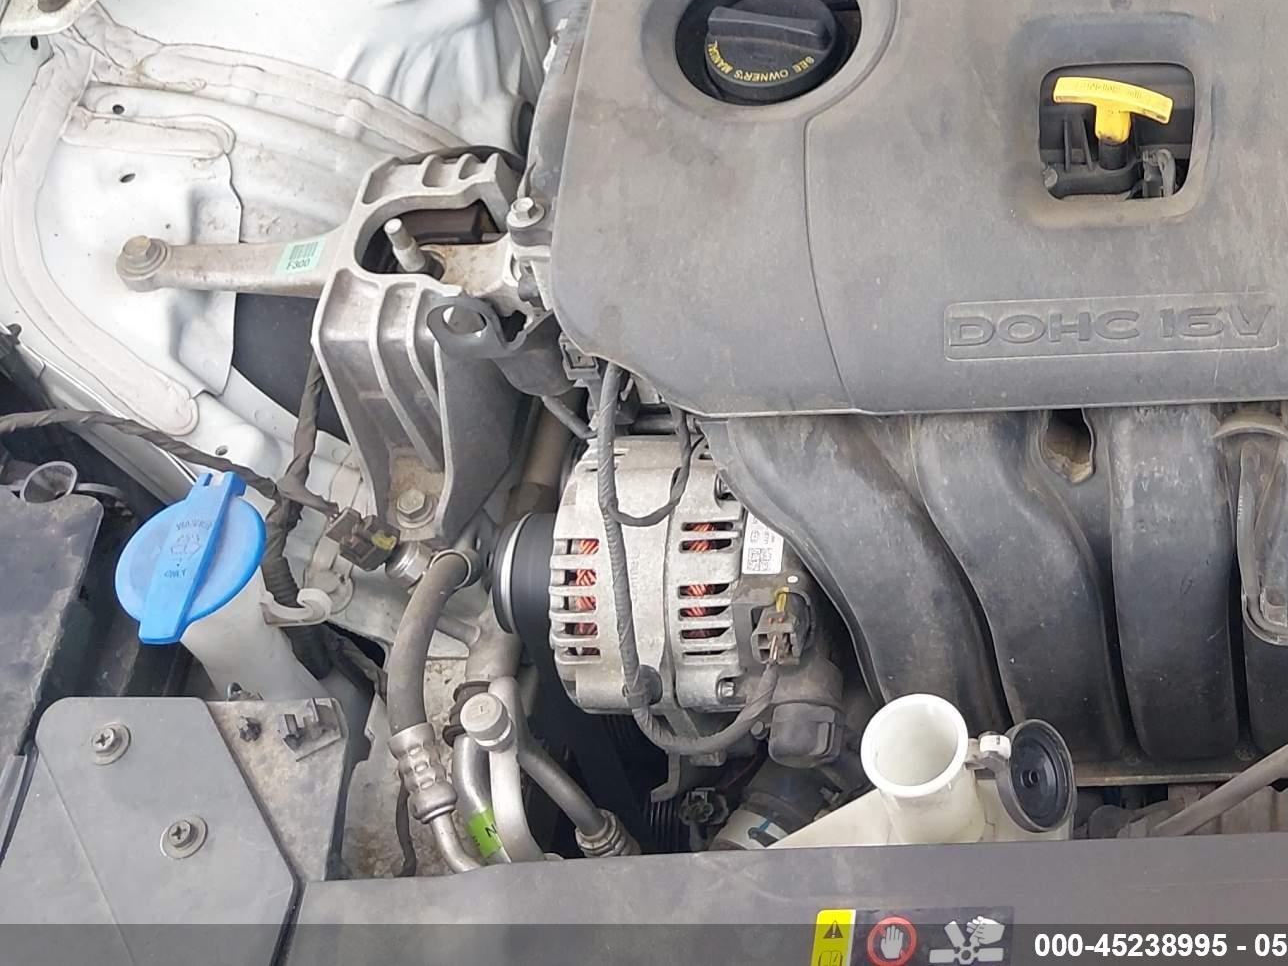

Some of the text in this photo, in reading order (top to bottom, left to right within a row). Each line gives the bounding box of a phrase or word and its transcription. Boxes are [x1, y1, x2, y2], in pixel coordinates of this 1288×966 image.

[792, 56, 815, 74] SEE
[734, 69, 789, 82] OWNER'S
[950, 305, 1275, 346] DOHC 16V
